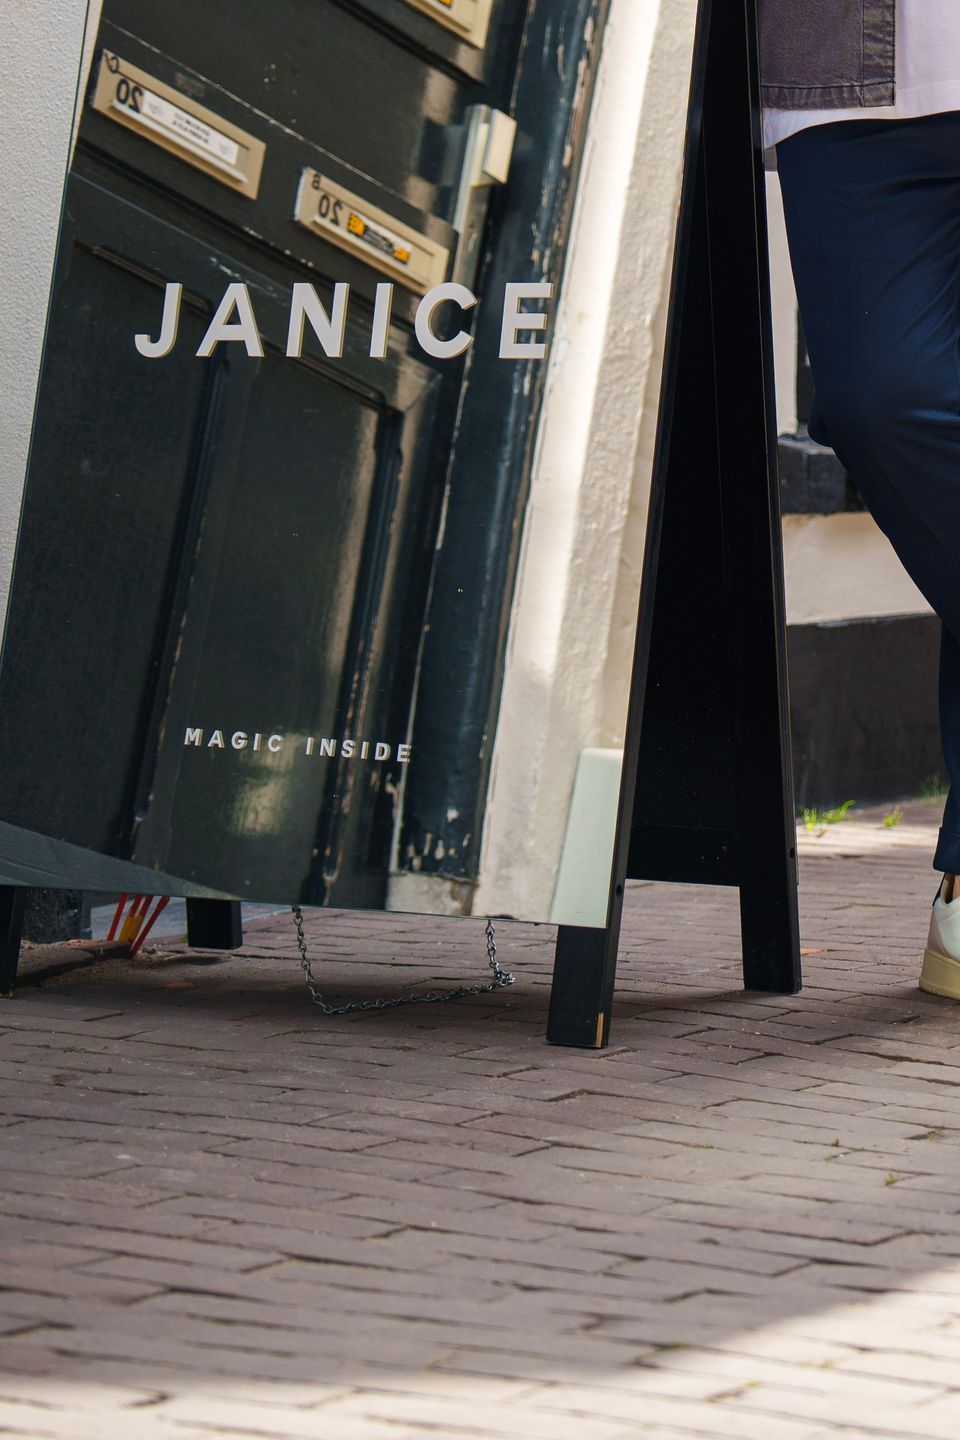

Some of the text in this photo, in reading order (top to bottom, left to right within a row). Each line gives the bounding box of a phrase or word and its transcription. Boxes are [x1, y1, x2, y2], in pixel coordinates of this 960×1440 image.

[134, 282, 554, 359] JANICE
[184, 727, 413, 763] MAGIC INSIDE
